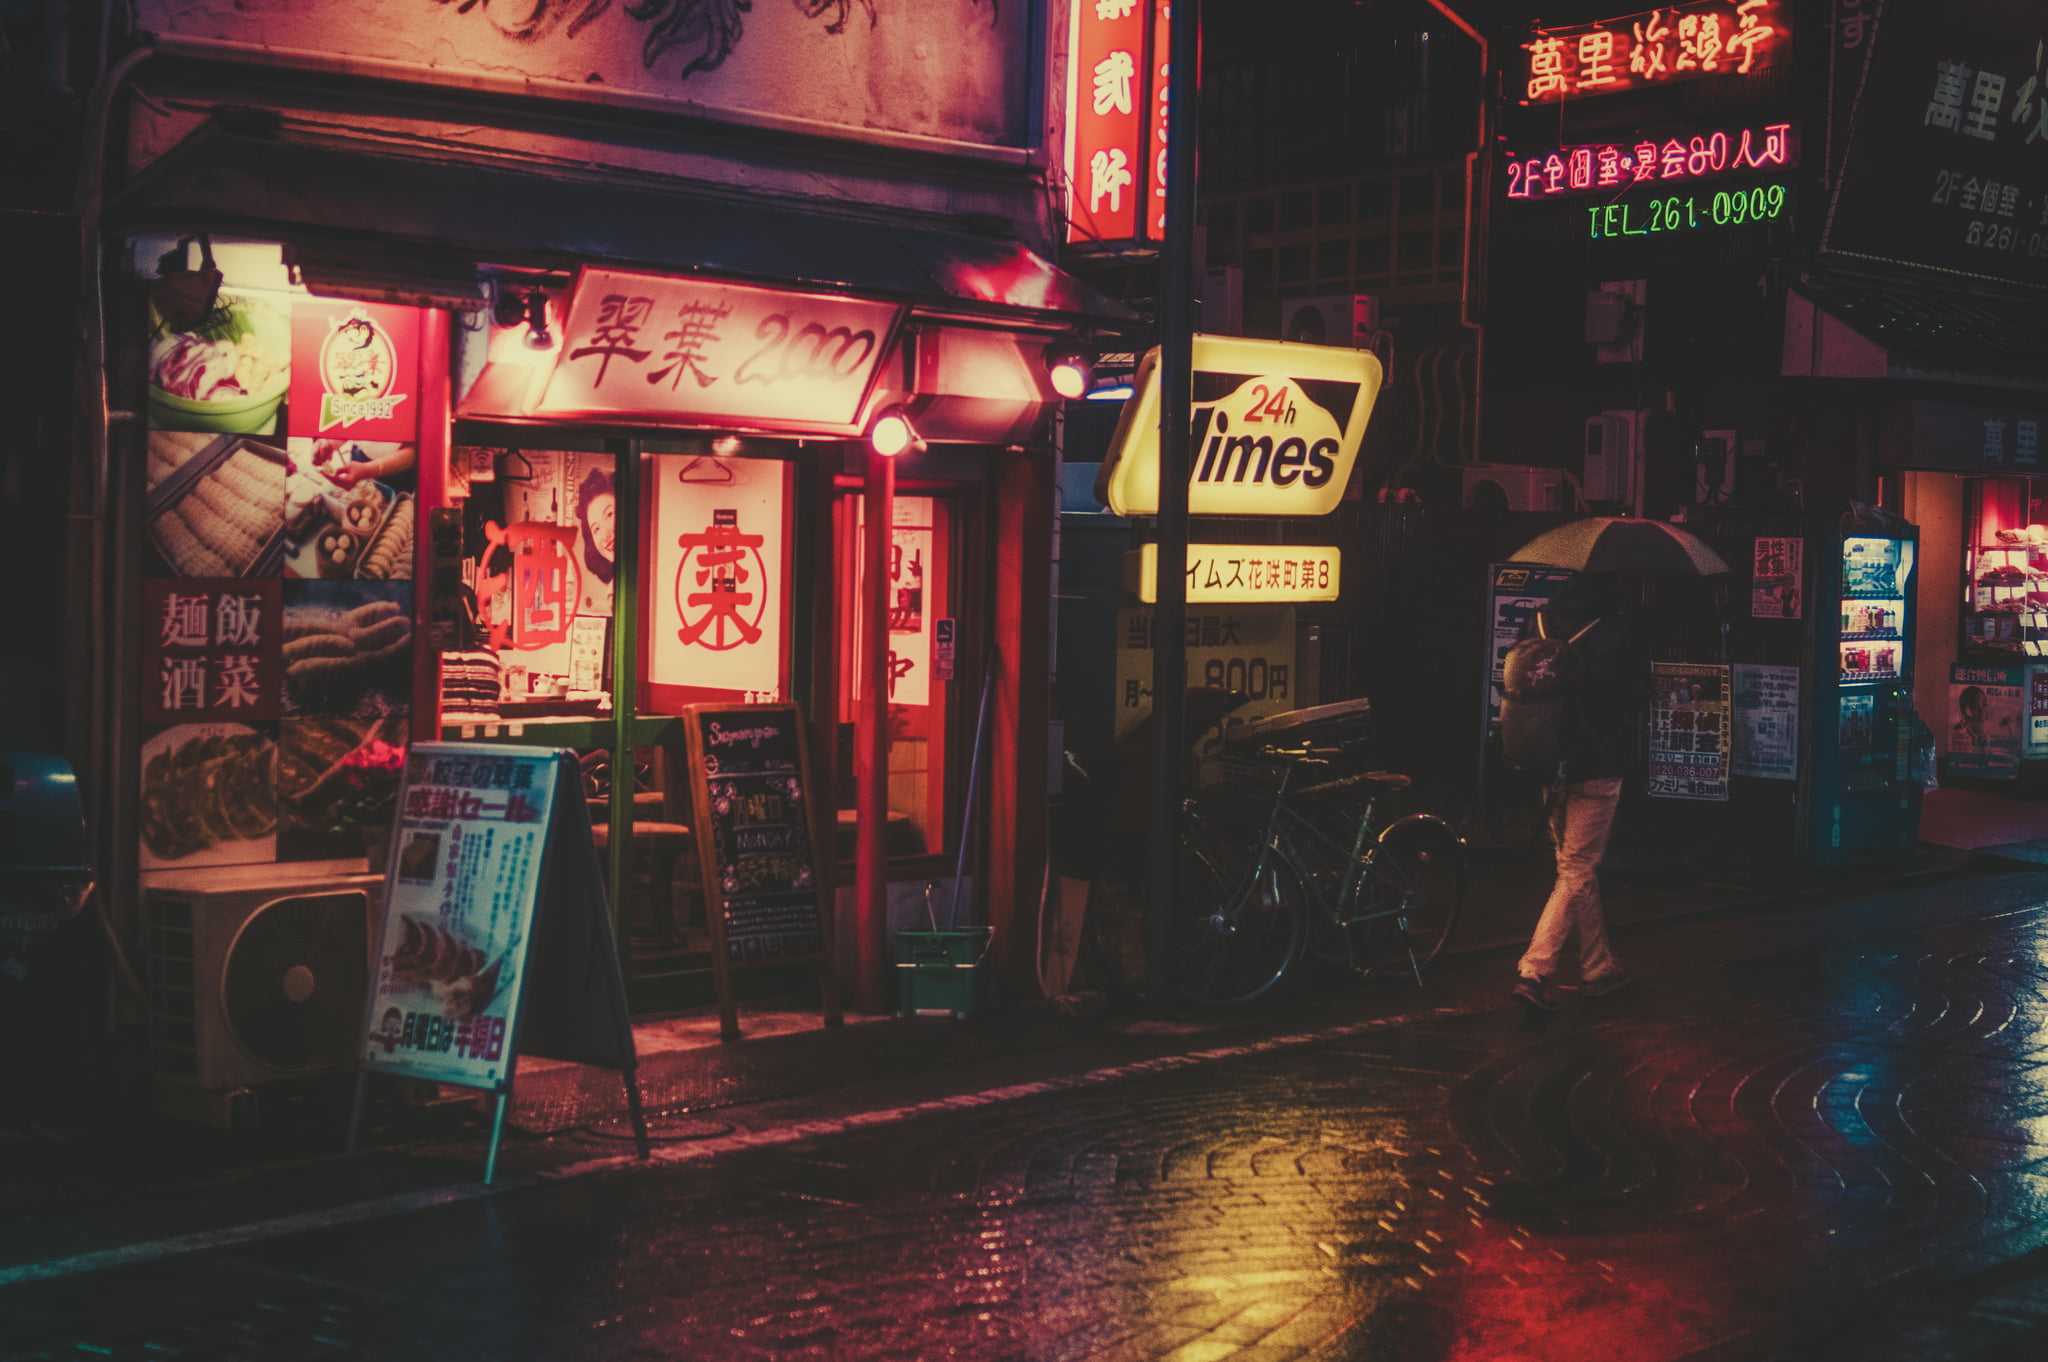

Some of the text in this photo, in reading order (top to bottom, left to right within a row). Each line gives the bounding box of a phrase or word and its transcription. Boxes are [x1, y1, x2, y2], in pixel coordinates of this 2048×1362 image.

[1840, 0, 1872, 49] す
[1588, 184, 1786, 239] TEL 261-0909
[1931, 169, 2048, 227] 2F全個室・
[734, 310, 866, 386] 2000
[677, 525, 765, 646] 菜
[1187, 558, 1329, 590] イムズ花咲町第8
[404, 787, 542, 822] 感謝セール
